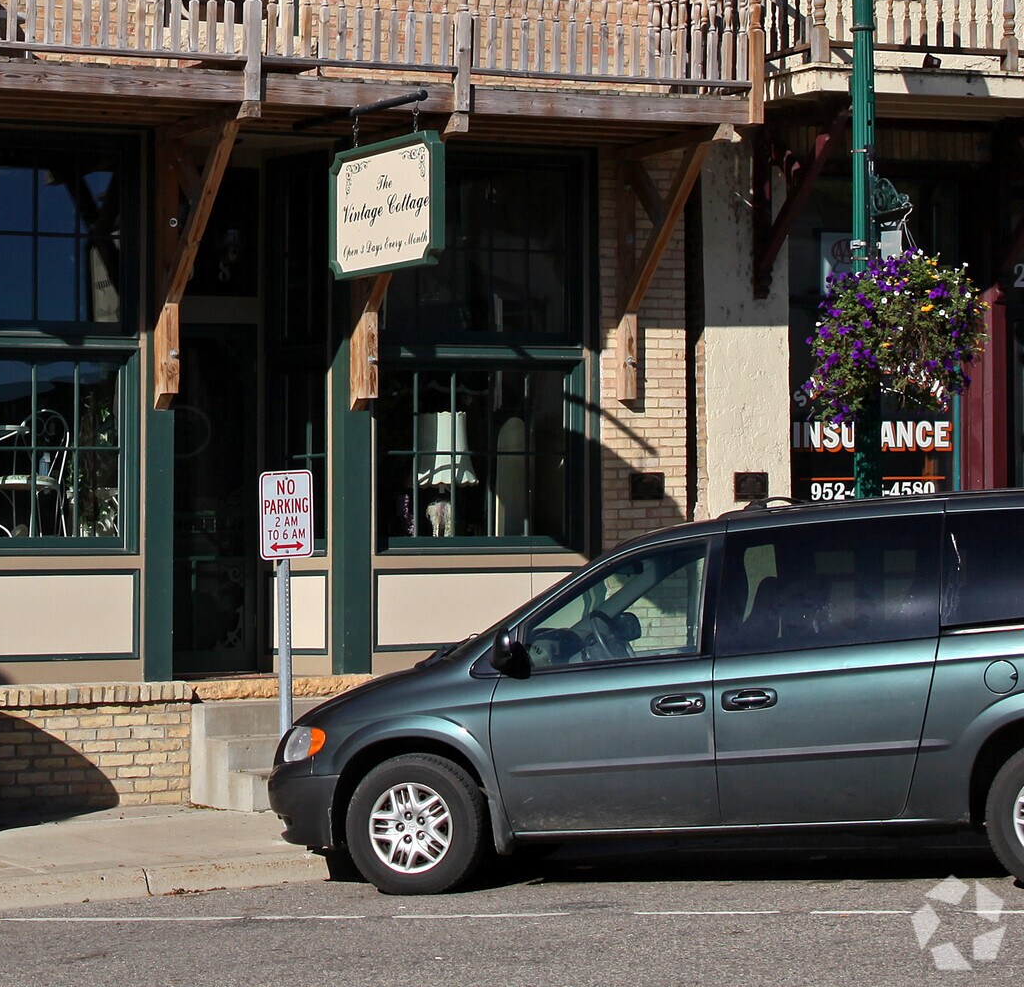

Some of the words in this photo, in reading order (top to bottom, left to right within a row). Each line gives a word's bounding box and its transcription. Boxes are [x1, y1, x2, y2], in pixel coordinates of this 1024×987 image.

[376, 175, 392, 191] The
[343, 203, 383, 227] Vintage
[387, 193, 430, 217] Cottage
[343, 245, 358, 261] Open
[360, 245, 365, 254] 3
[366, 240, 382, 257] Days
[384, 237, 402, 253] Every
[404, 230, 427, 246] Month
[793, 421, 951, 450] INSUANCE
[277, 479, 295, 495] NO
[264, 497, 309, 515] PARKING
[275, 516, 281, 527] 2
[284, 516, 298, 527] AM
[268, 529, 279, 540] TO
[282, 529, 289, 540] 6
[292, 528, 305, 539] AM
